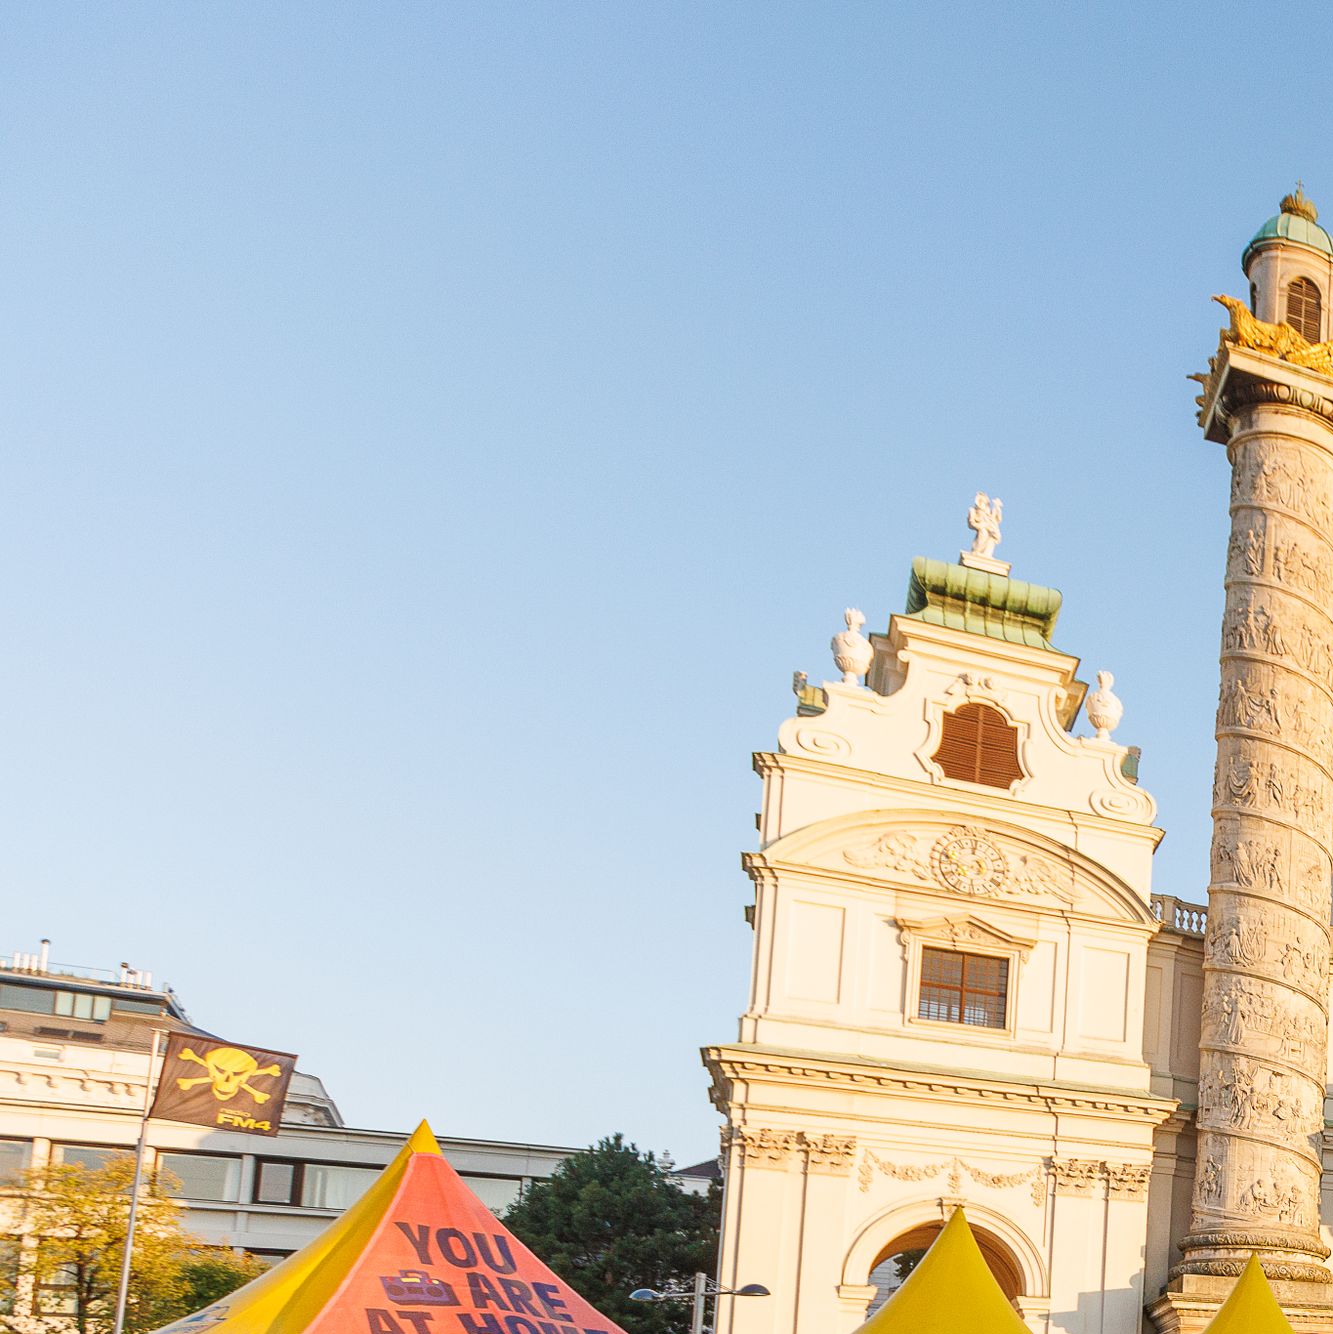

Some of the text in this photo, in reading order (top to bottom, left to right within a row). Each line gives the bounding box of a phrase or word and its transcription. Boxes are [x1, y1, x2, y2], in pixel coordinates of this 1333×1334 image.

[216, 1113, 271, 1131] FM4
[395, 1221, 518, 1275] YOU
[466, 1272, 574, 1323] ARE
